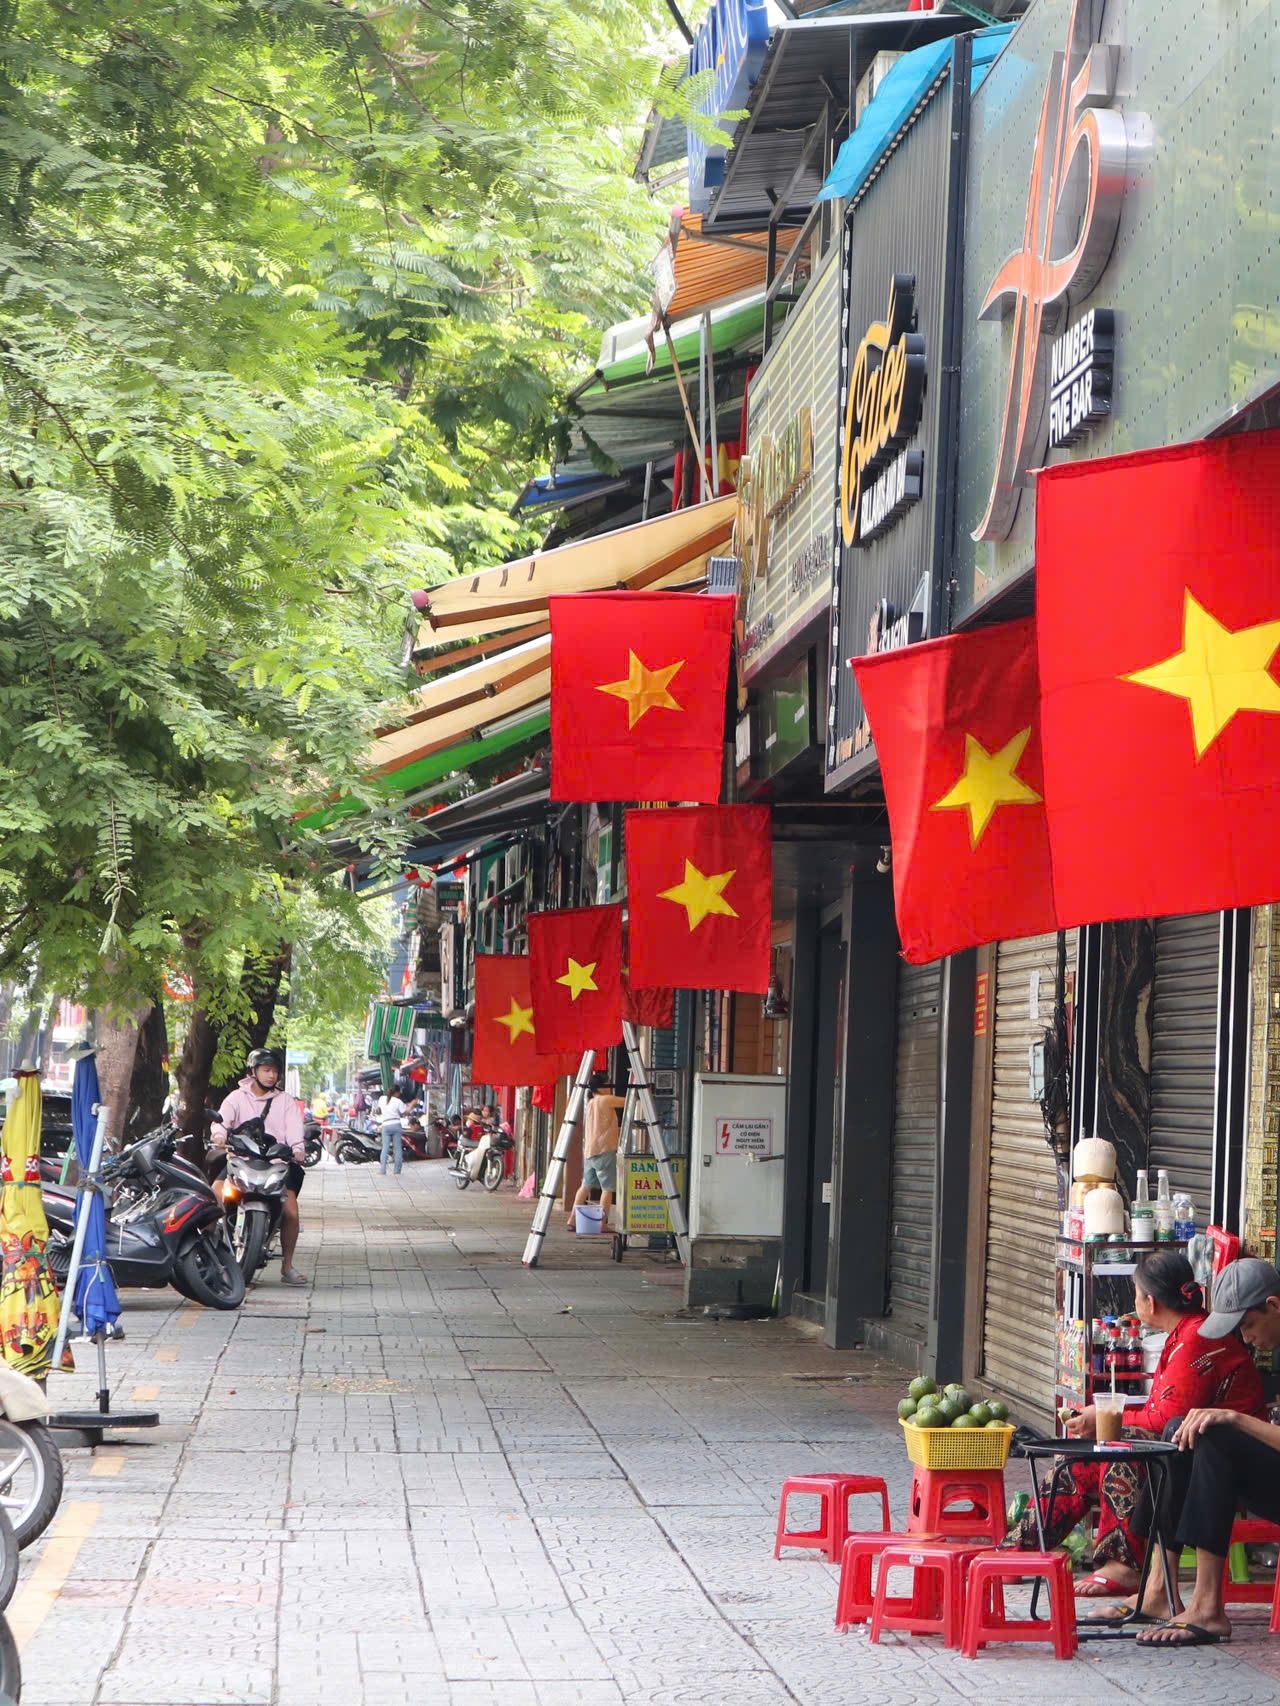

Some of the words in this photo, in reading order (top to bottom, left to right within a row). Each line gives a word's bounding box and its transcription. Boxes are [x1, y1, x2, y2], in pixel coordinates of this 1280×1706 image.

[1051, 308, 1095, 388] NUMBER
[1049, 388, 1071, 448] FIVE
[1071, 368, 1093, 430] BAR
